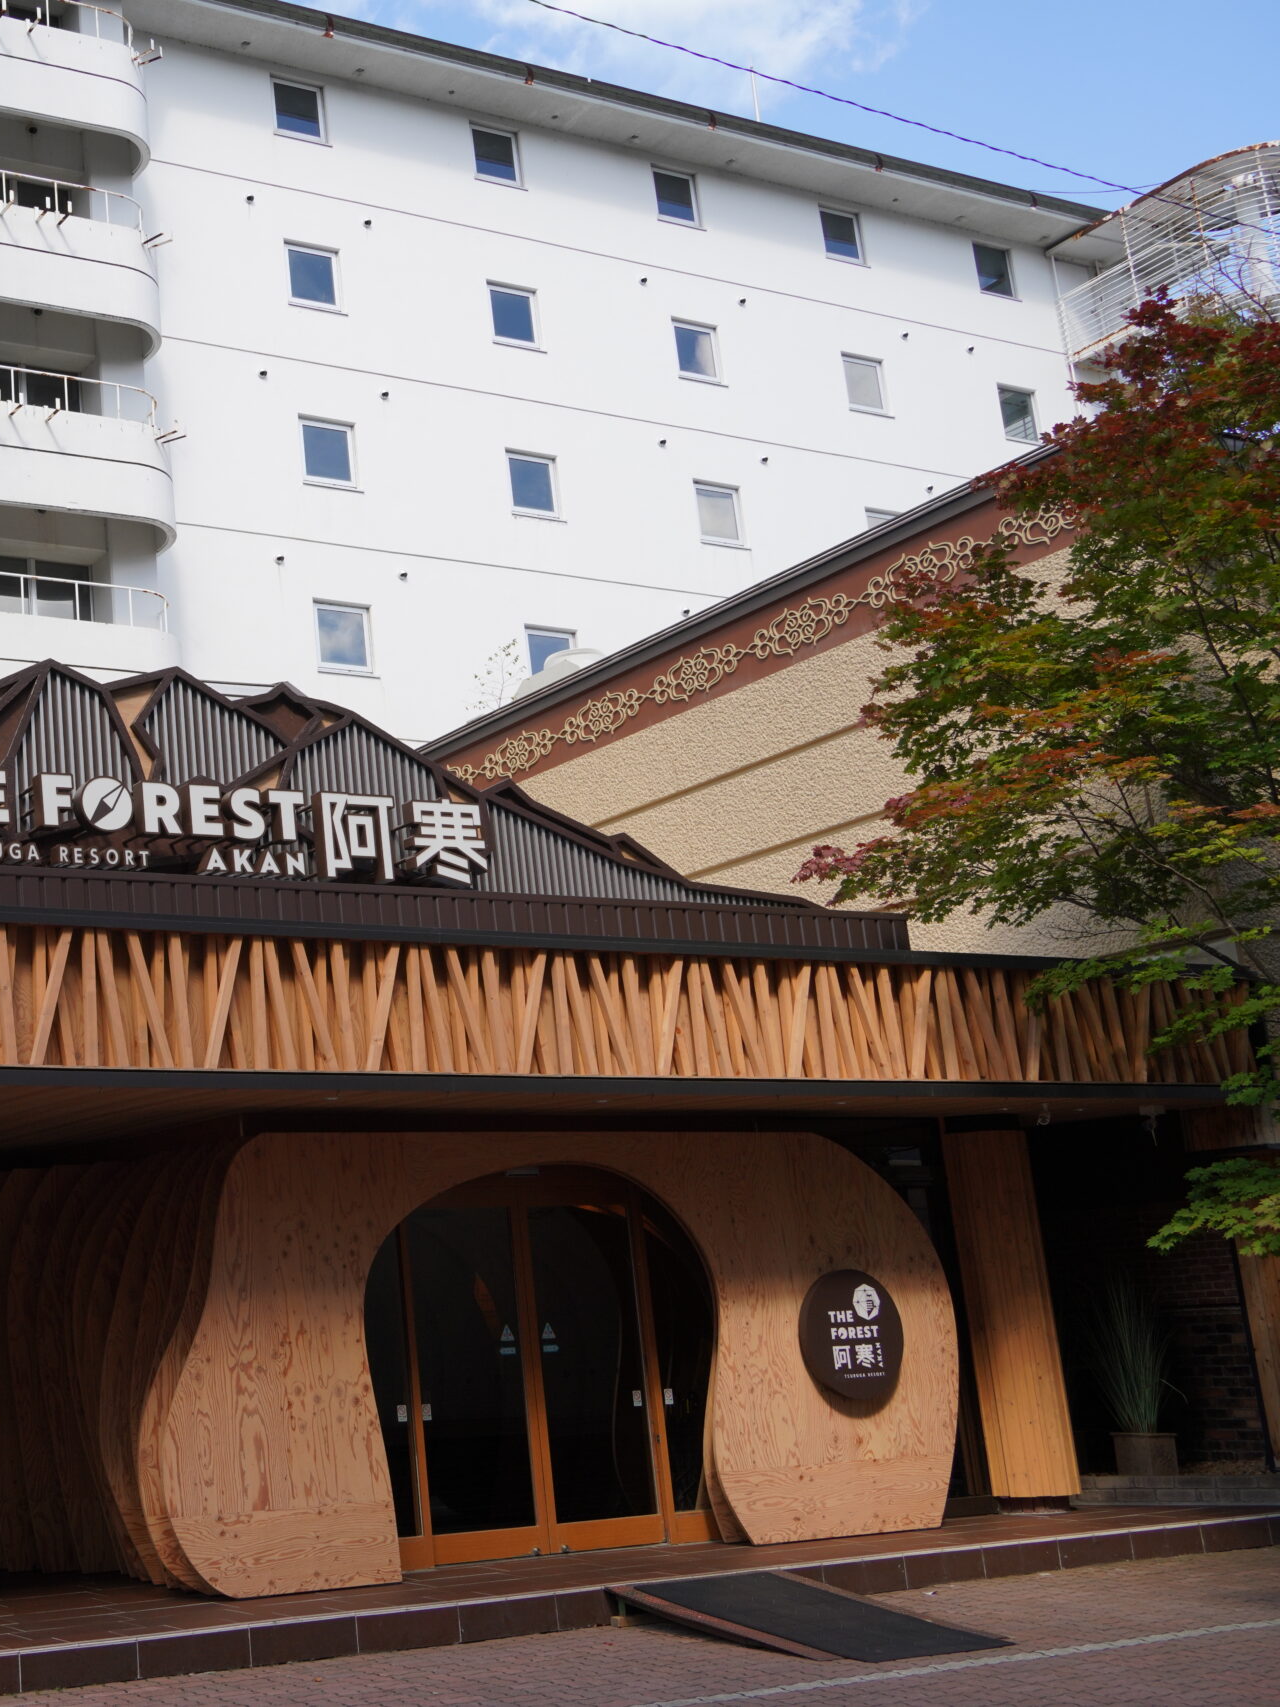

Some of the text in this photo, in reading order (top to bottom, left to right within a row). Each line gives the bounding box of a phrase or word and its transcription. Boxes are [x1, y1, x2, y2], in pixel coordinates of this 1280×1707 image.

[40, 772, 305, 842] FOREST
[320, 791, 489, 885] 阿寒
[59, 846, 150, 867] RESORT
[206, 848, 306, 876] AKAN
[828, 1310, 854, 1323] THE
[831, 1325, 879, 1340] FOREST
[832, 1344, 875, 1370] 阿寒
